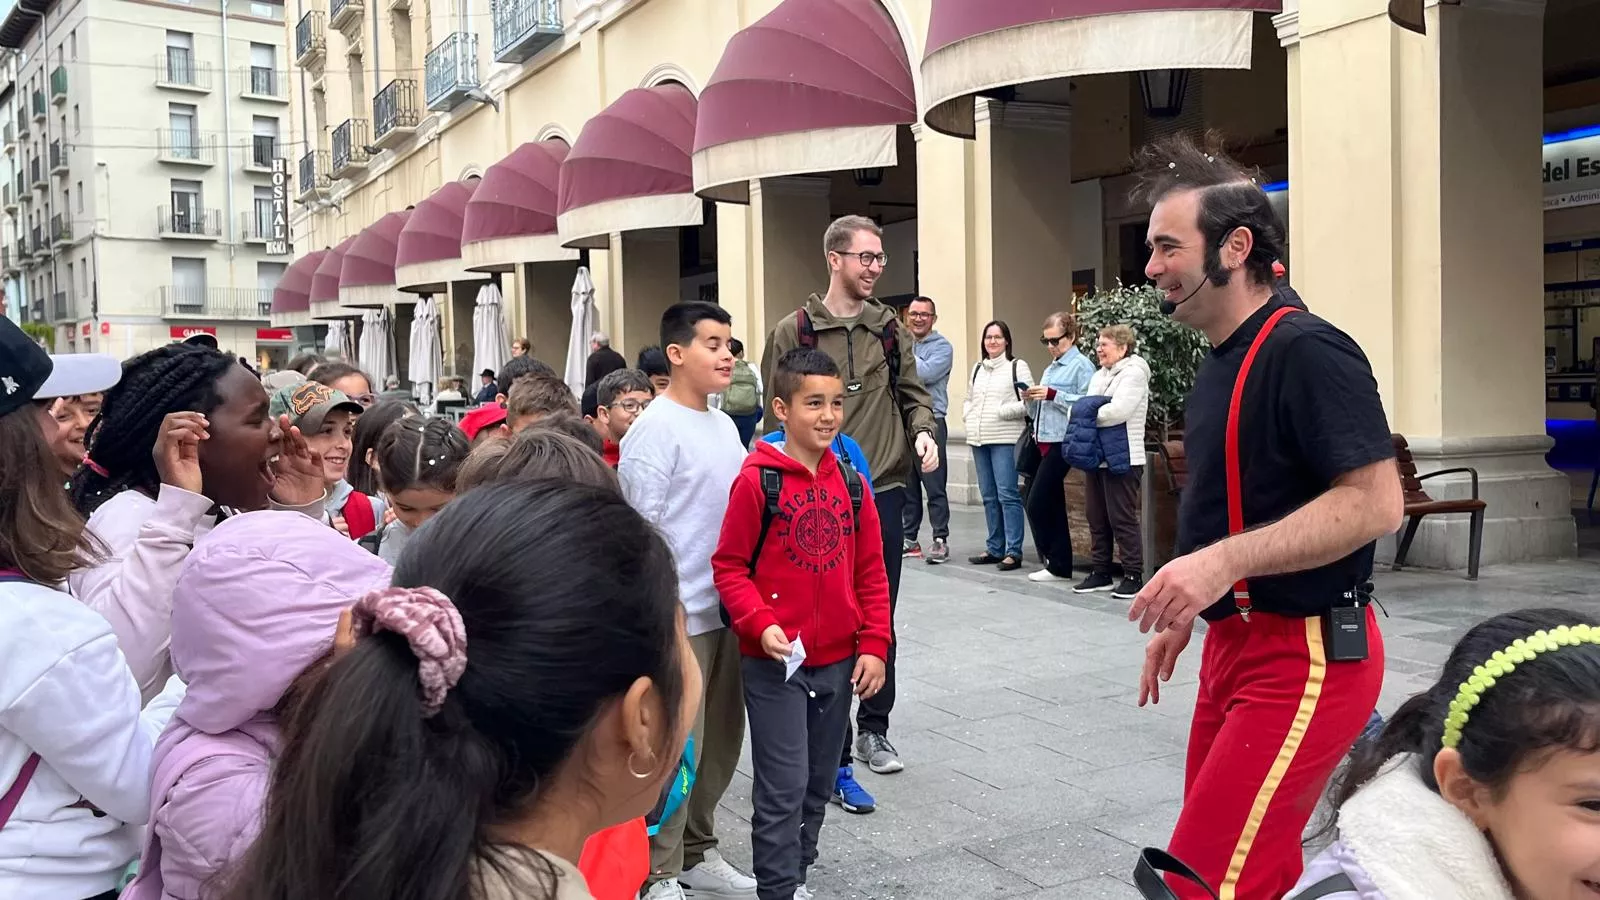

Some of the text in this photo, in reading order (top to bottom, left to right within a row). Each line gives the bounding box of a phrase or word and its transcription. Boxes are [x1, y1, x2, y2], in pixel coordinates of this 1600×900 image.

[1543, 157, 1600, 183] del Es
[272, 159, 285, 239] HOSTAL
[777, 487, 853, 537] LEICESTER
